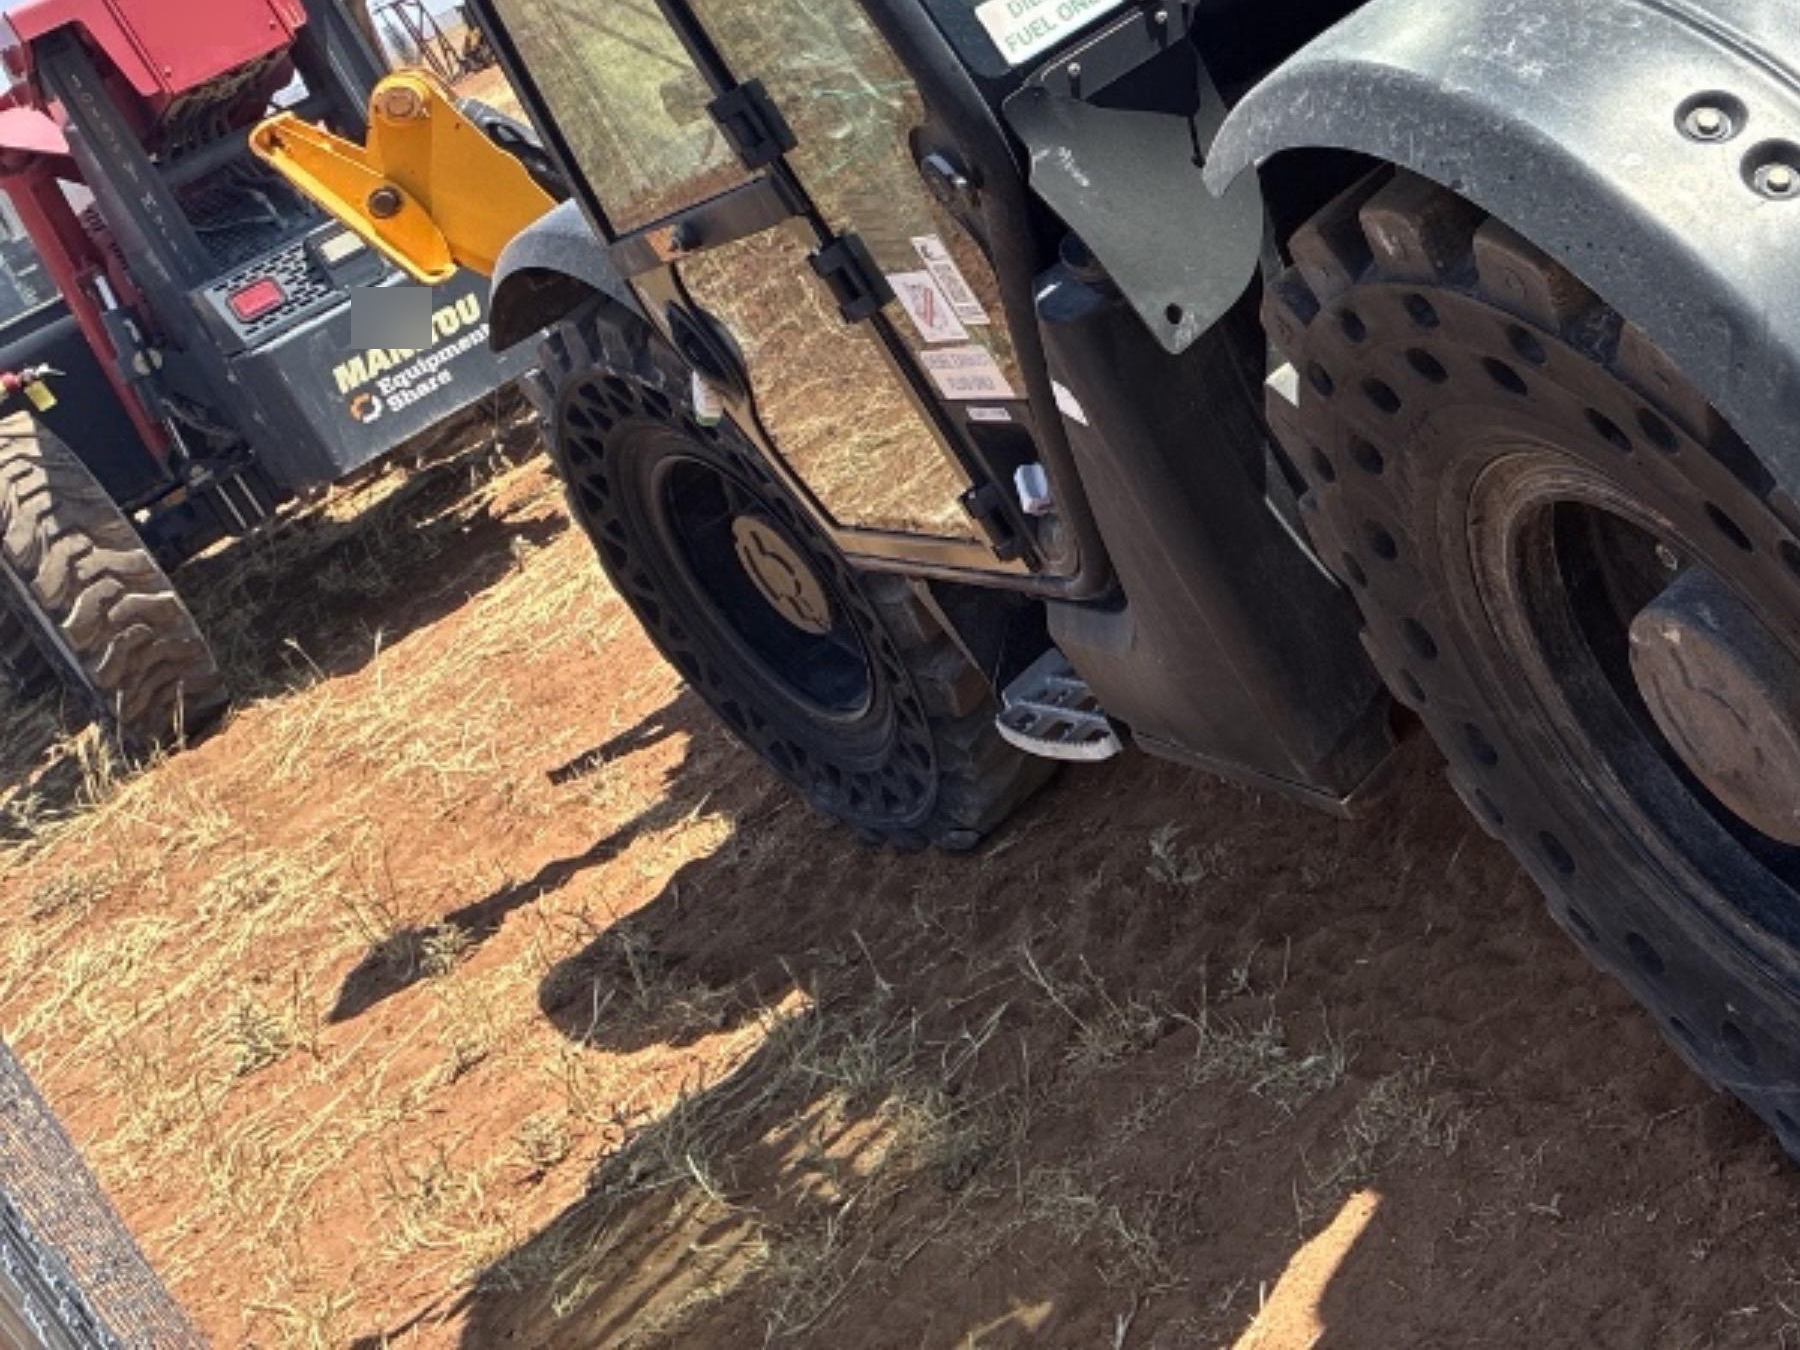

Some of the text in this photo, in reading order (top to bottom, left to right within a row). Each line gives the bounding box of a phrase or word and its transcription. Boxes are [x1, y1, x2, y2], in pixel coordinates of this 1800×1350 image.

[1004, 13, 1059, 53] FUEL
[332, 292, 482, 394] MANOU
[386, 368, 454, 413] Share
